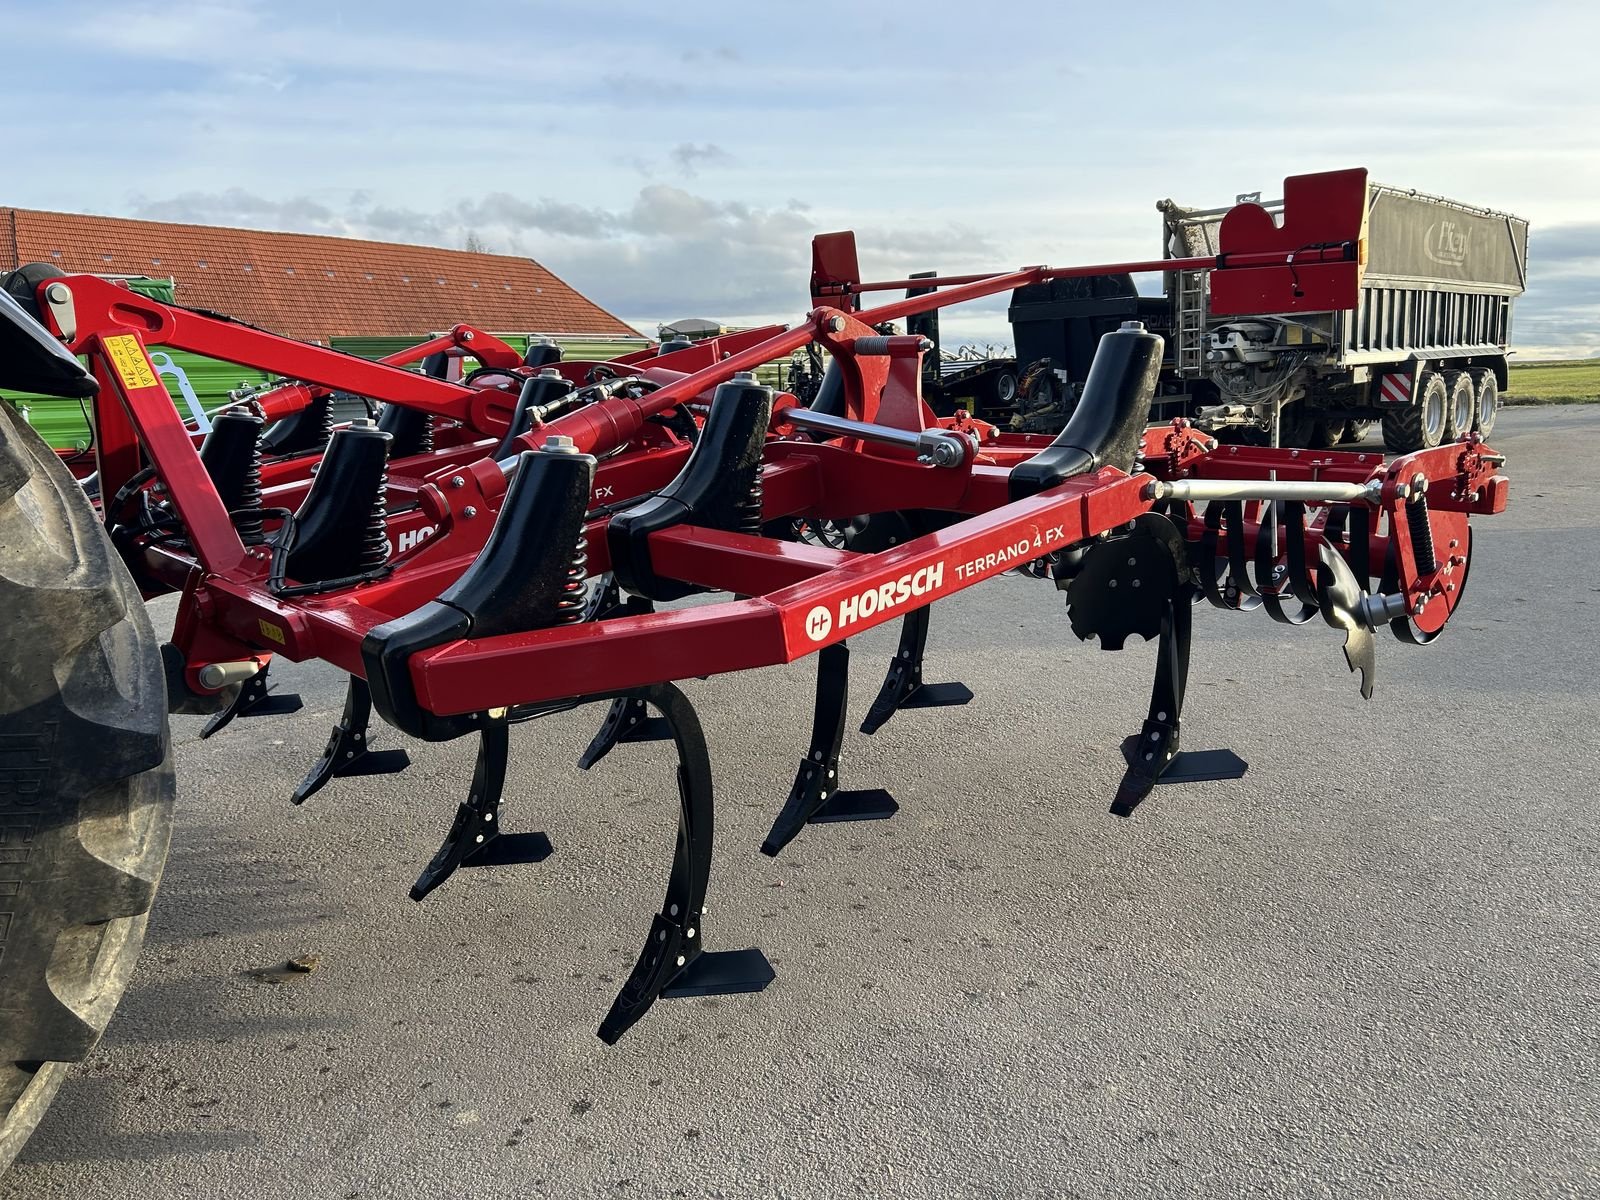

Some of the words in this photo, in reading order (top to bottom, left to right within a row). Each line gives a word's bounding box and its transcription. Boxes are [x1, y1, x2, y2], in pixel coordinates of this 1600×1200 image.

[595, 486, 614, 499] FX
[838, 561, 945, 628] HORSCH
[955, 540, 1030, 580] TERRANO
[1033, 533, 1043, 548] 4
[1045, 525, 1064, 544] FX
